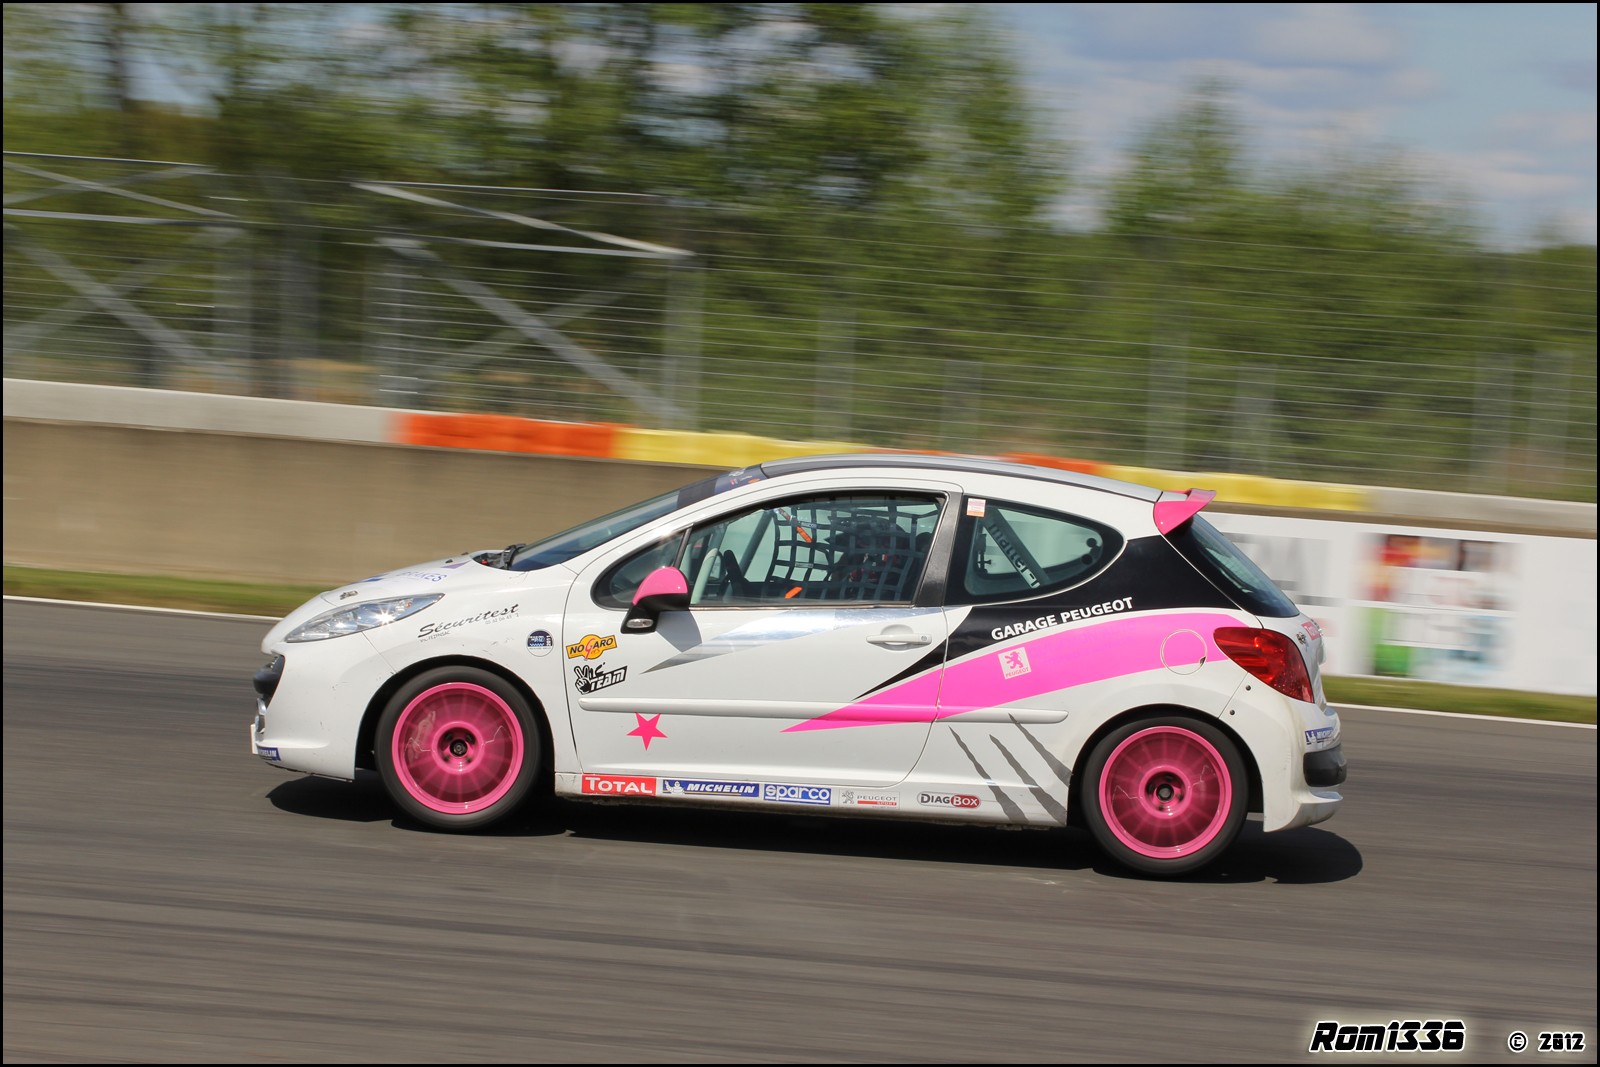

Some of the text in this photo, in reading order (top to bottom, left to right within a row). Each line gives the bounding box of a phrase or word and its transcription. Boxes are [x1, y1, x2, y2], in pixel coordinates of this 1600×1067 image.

[418, 603, 519, 638] Sécuritest
[991, 597, 1133, 641] GARAGE PEUGEOT
[569, 637, 614, 661] NOGARO
[1005, 666, 1030, 678] PEUGEOT
[585, 776, 653, 794] TOTAL
[686, 783, 756, 794] MICHELIN
[765, 784, 829, 801] sparco
